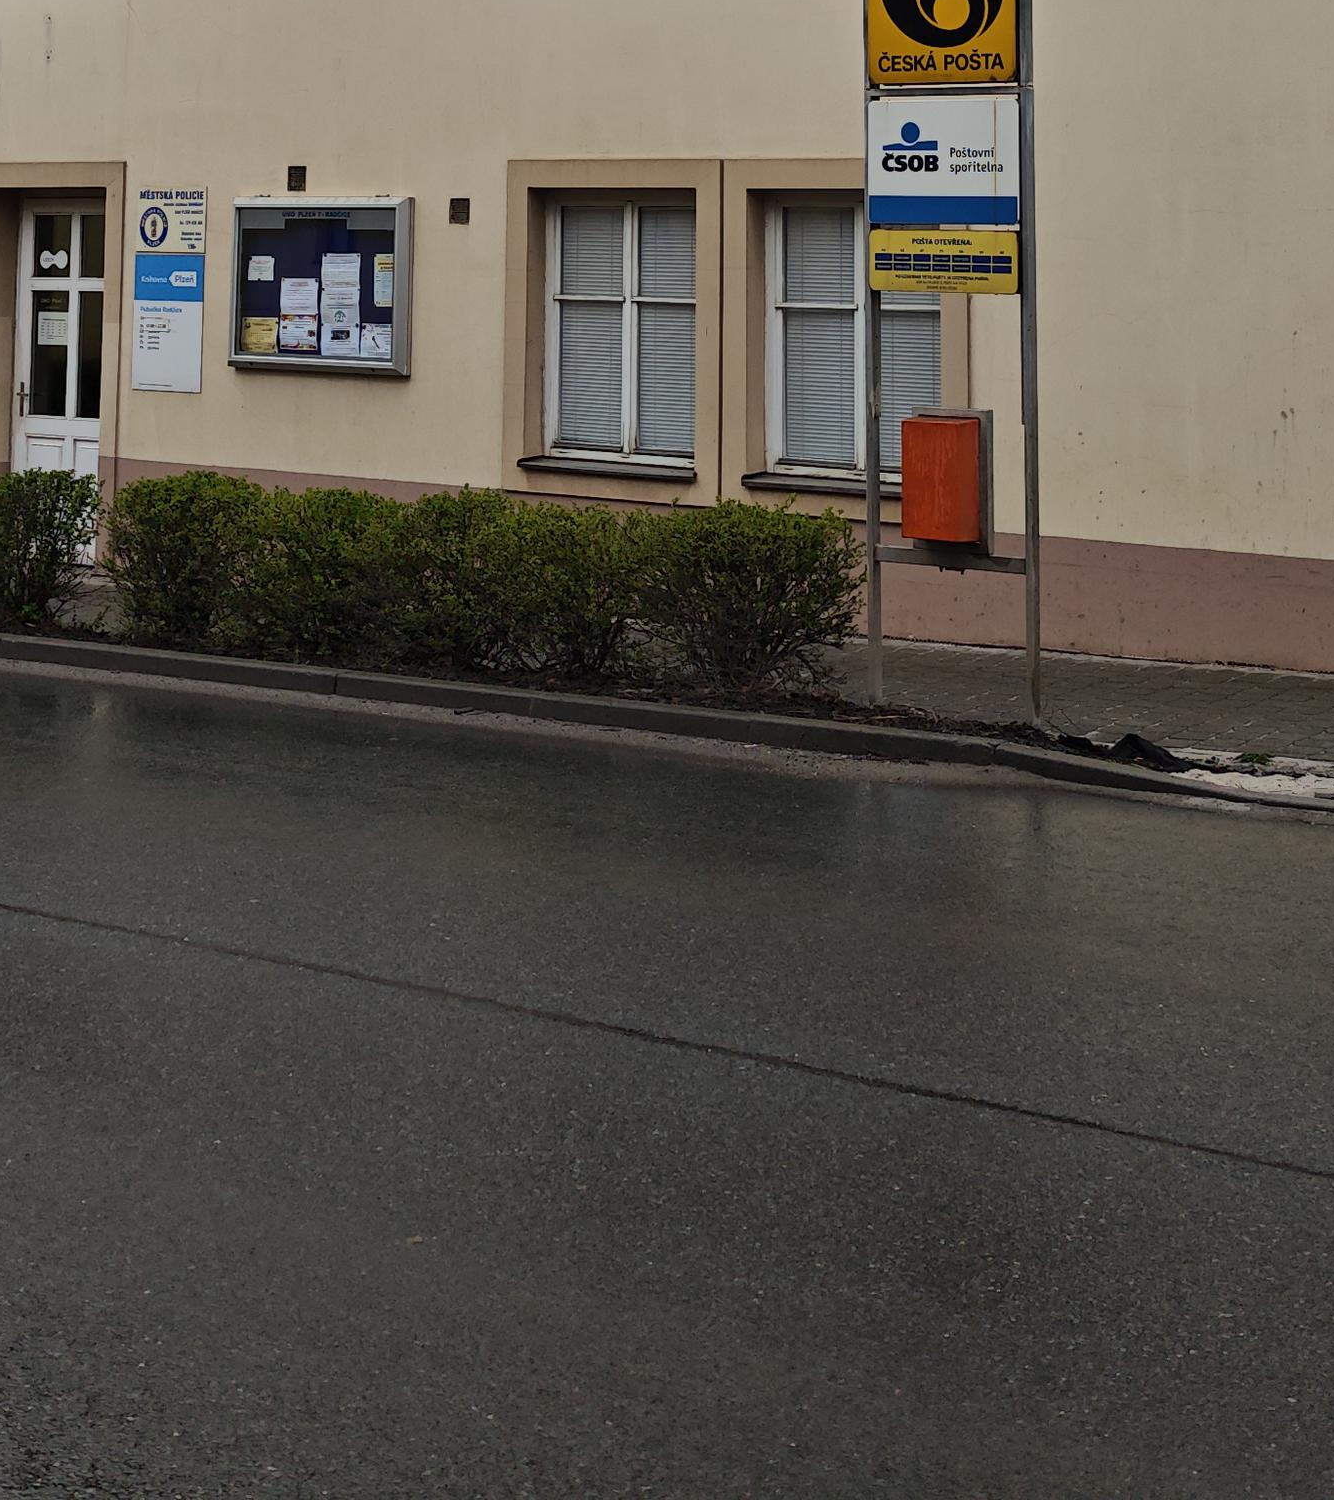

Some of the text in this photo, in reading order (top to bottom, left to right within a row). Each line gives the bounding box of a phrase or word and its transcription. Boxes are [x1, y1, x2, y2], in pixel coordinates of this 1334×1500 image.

[877, 49, 1005, 73] ČESKÁ POŠTA
[949, 147, 995, 158] Poštovní
[881, 152, 939, 172] ČSOB
[949, 161, 1004, 175] spořitelna
[139, 188, 204, 200] MĚSTSKÁ POLICIE
[912, 237, 933, 245] POŠTA
[174, 274, 195, 283] Plzeň
